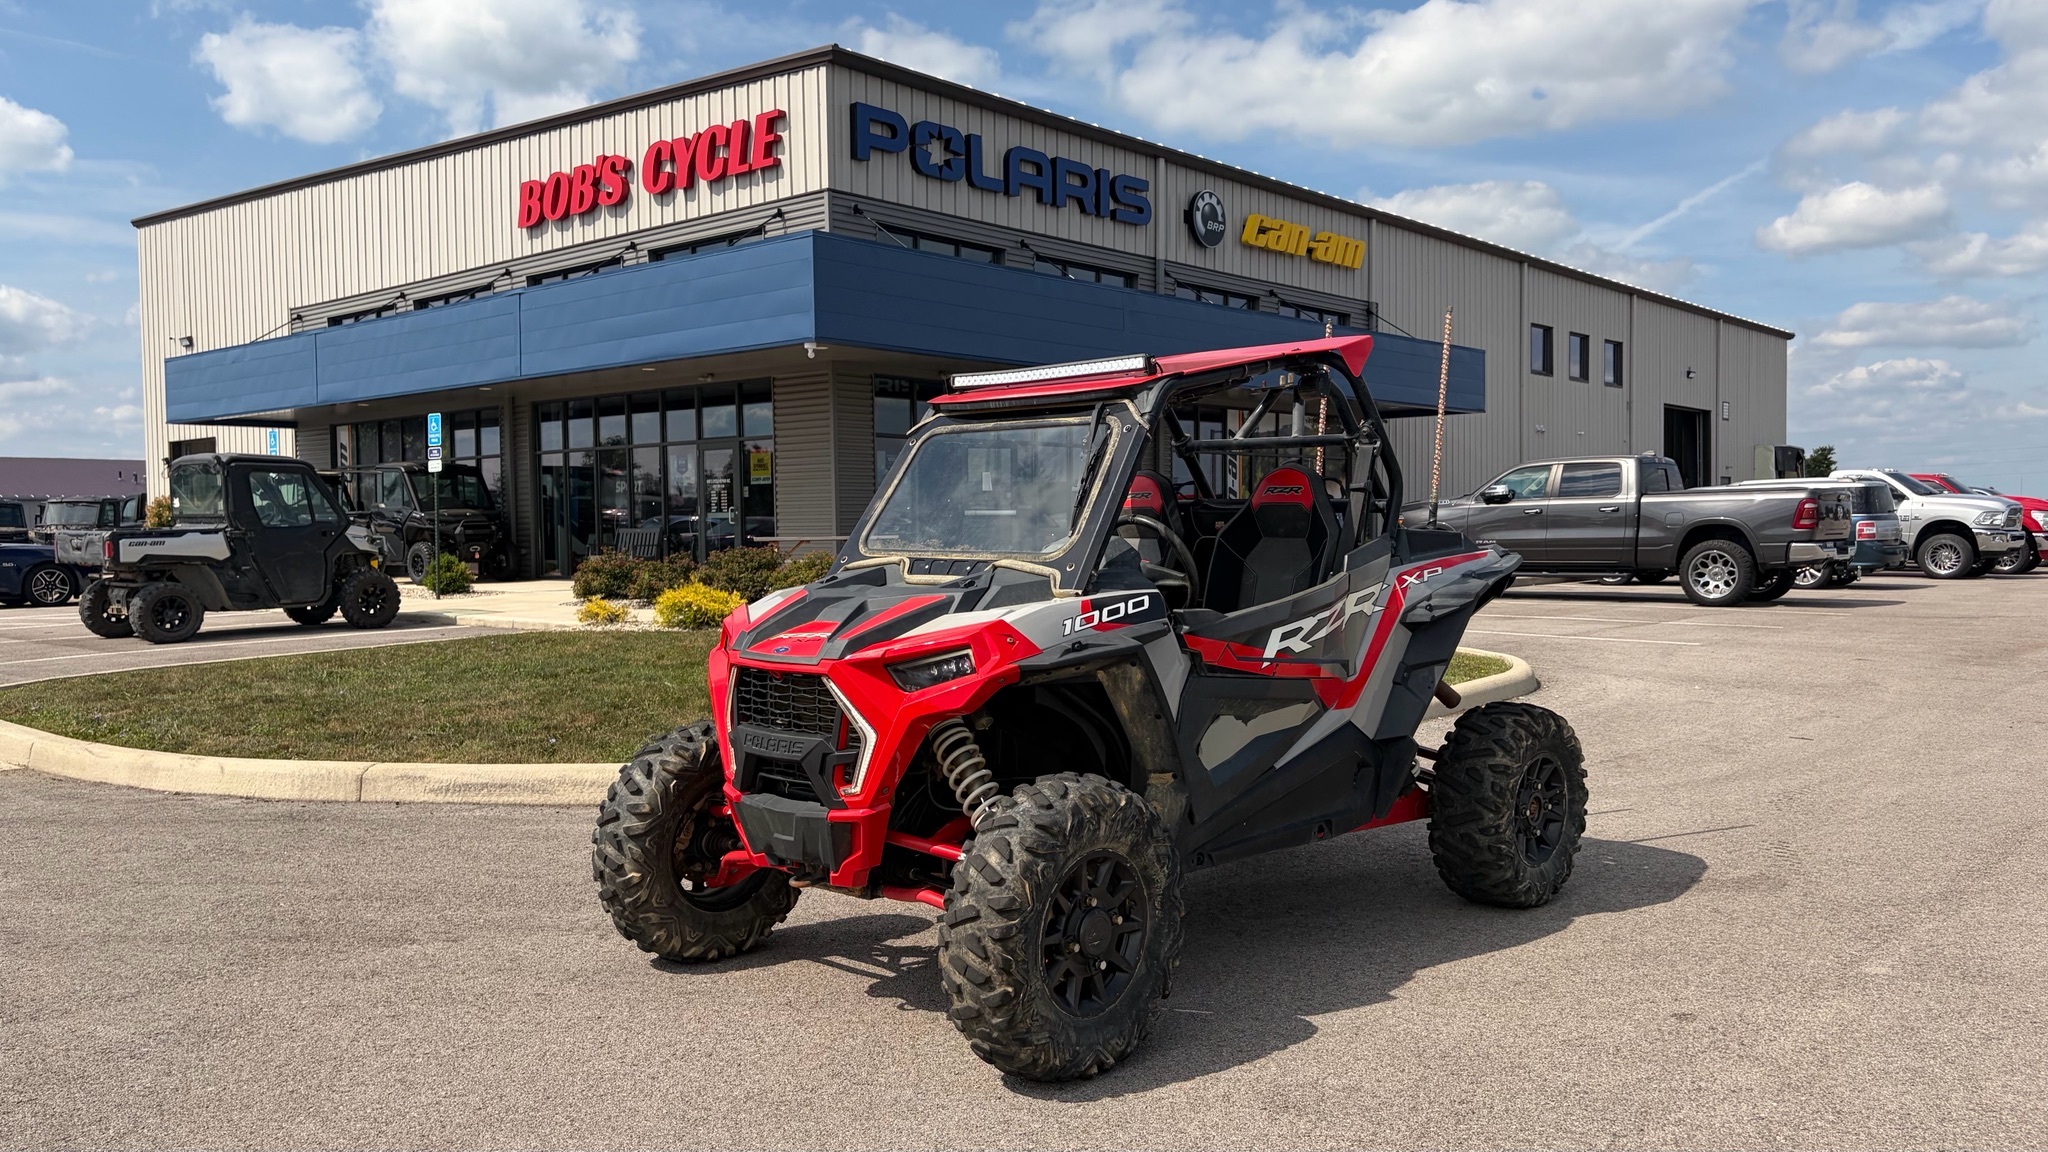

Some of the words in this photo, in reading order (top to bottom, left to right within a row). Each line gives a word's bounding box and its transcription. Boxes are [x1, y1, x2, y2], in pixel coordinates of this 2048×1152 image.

[518, 154, 631, 228] BOB'S
[642, 109, 786, 195] CYCLE
[850, 101, 1152, 225] POLARIS
[1206, 220, 1225, 232] BRP
[1241, 213, 1366, 270] can-am
[1262, 485, 1304, 496] RZR
[1400, 566, 1443, 589] XP
[1062, 594, 1150, 637] 1000
[1260, 581, 1390, 670] RZR
[743, 733, 805, 755] POLARIS
